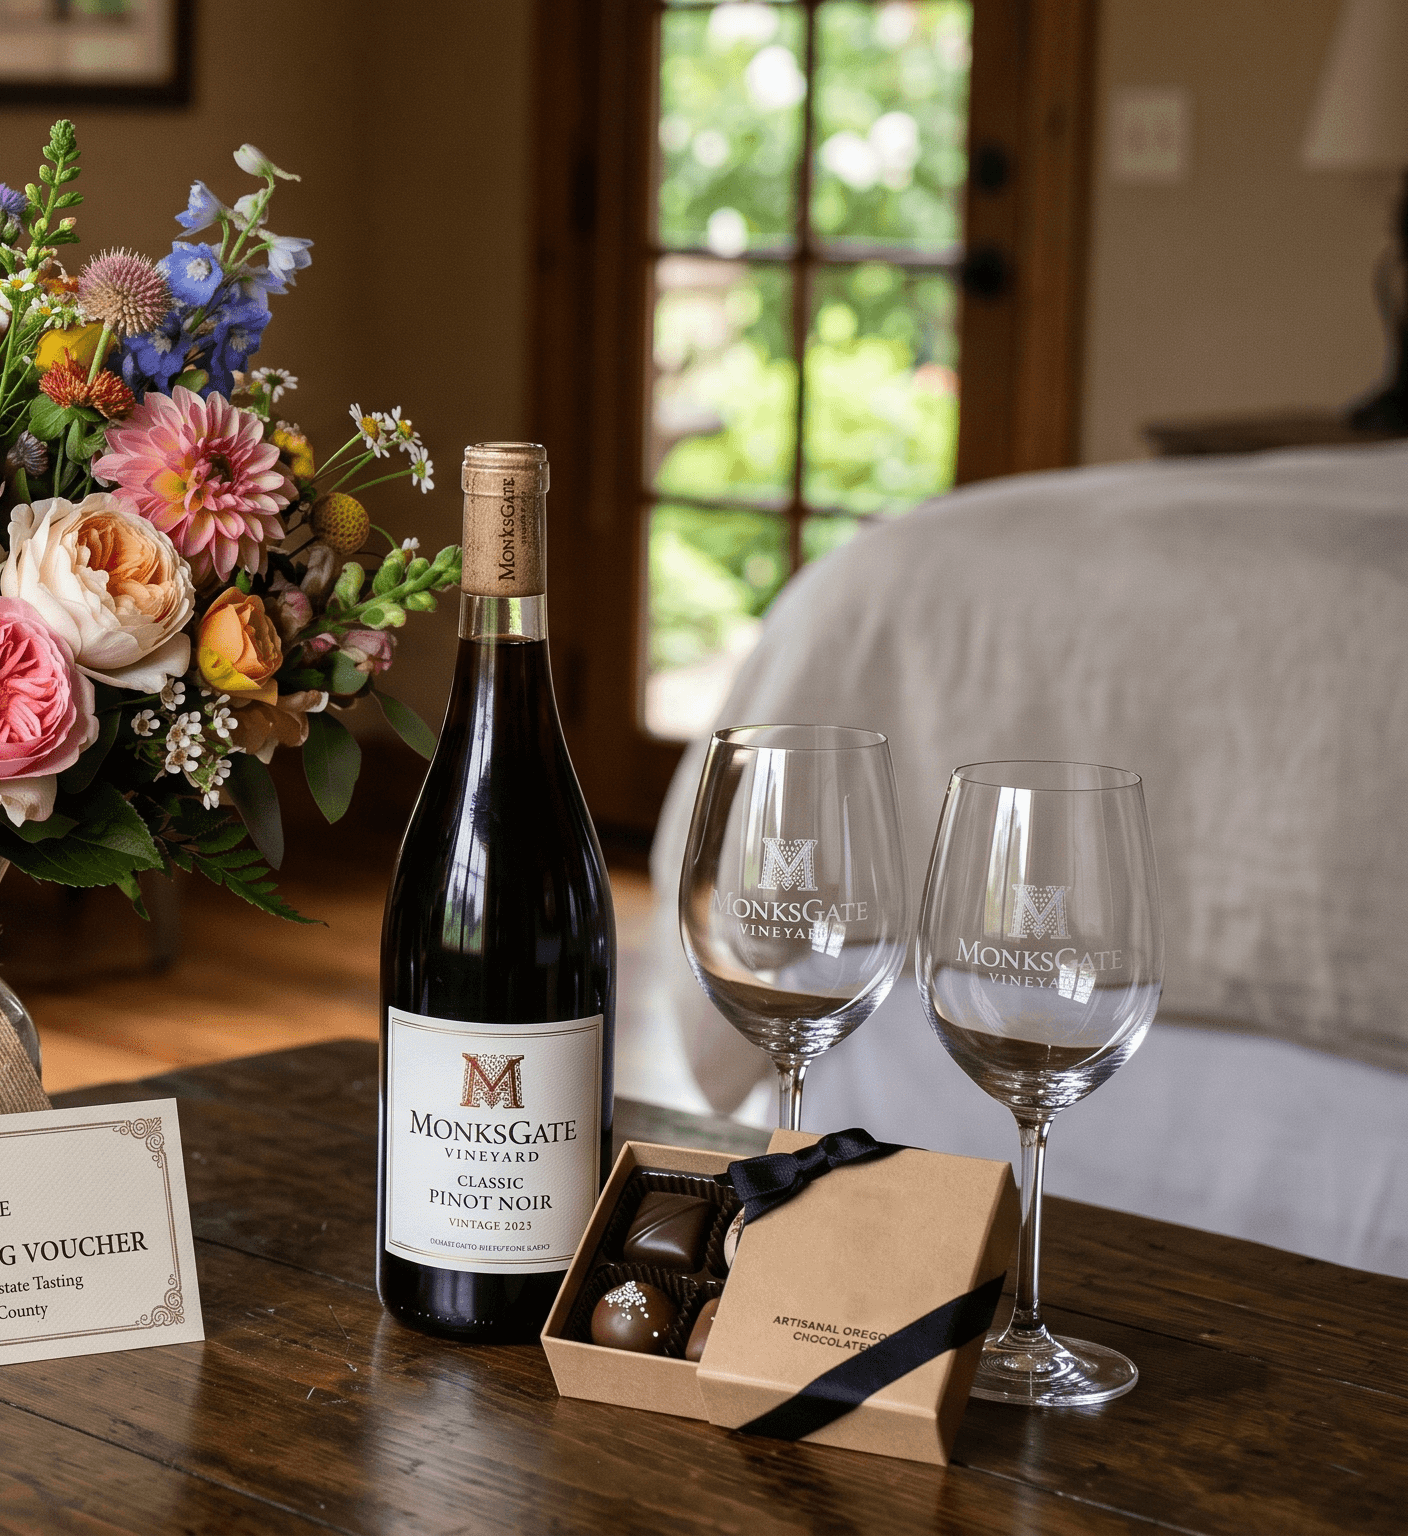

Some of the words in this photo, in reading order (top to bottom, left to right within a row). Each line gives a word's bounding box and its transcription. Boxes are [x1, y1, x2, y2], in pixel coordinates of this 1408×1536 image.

[757, 838, 818, 891] M
[1007, 884, 1071, 940] M
[459, 1052, 525, 1109] M
[444, 1147, 539, 1163] VINEYARD
[457, 1174, 524, 1190] CLASSIC
[429, 1188, 493, 1210] PINOT
[497, 1194, 553, 1211] NOIR
[448, 1217, 501, 1231] VINTAGE
[22, 1231, 149, 1263] VOUCHER
[32, 1274, 84, 1291] Tasting
[772, 1315, 840, 1335] ARTISANAL
[843, 1326, 889, 1342] OREGO
